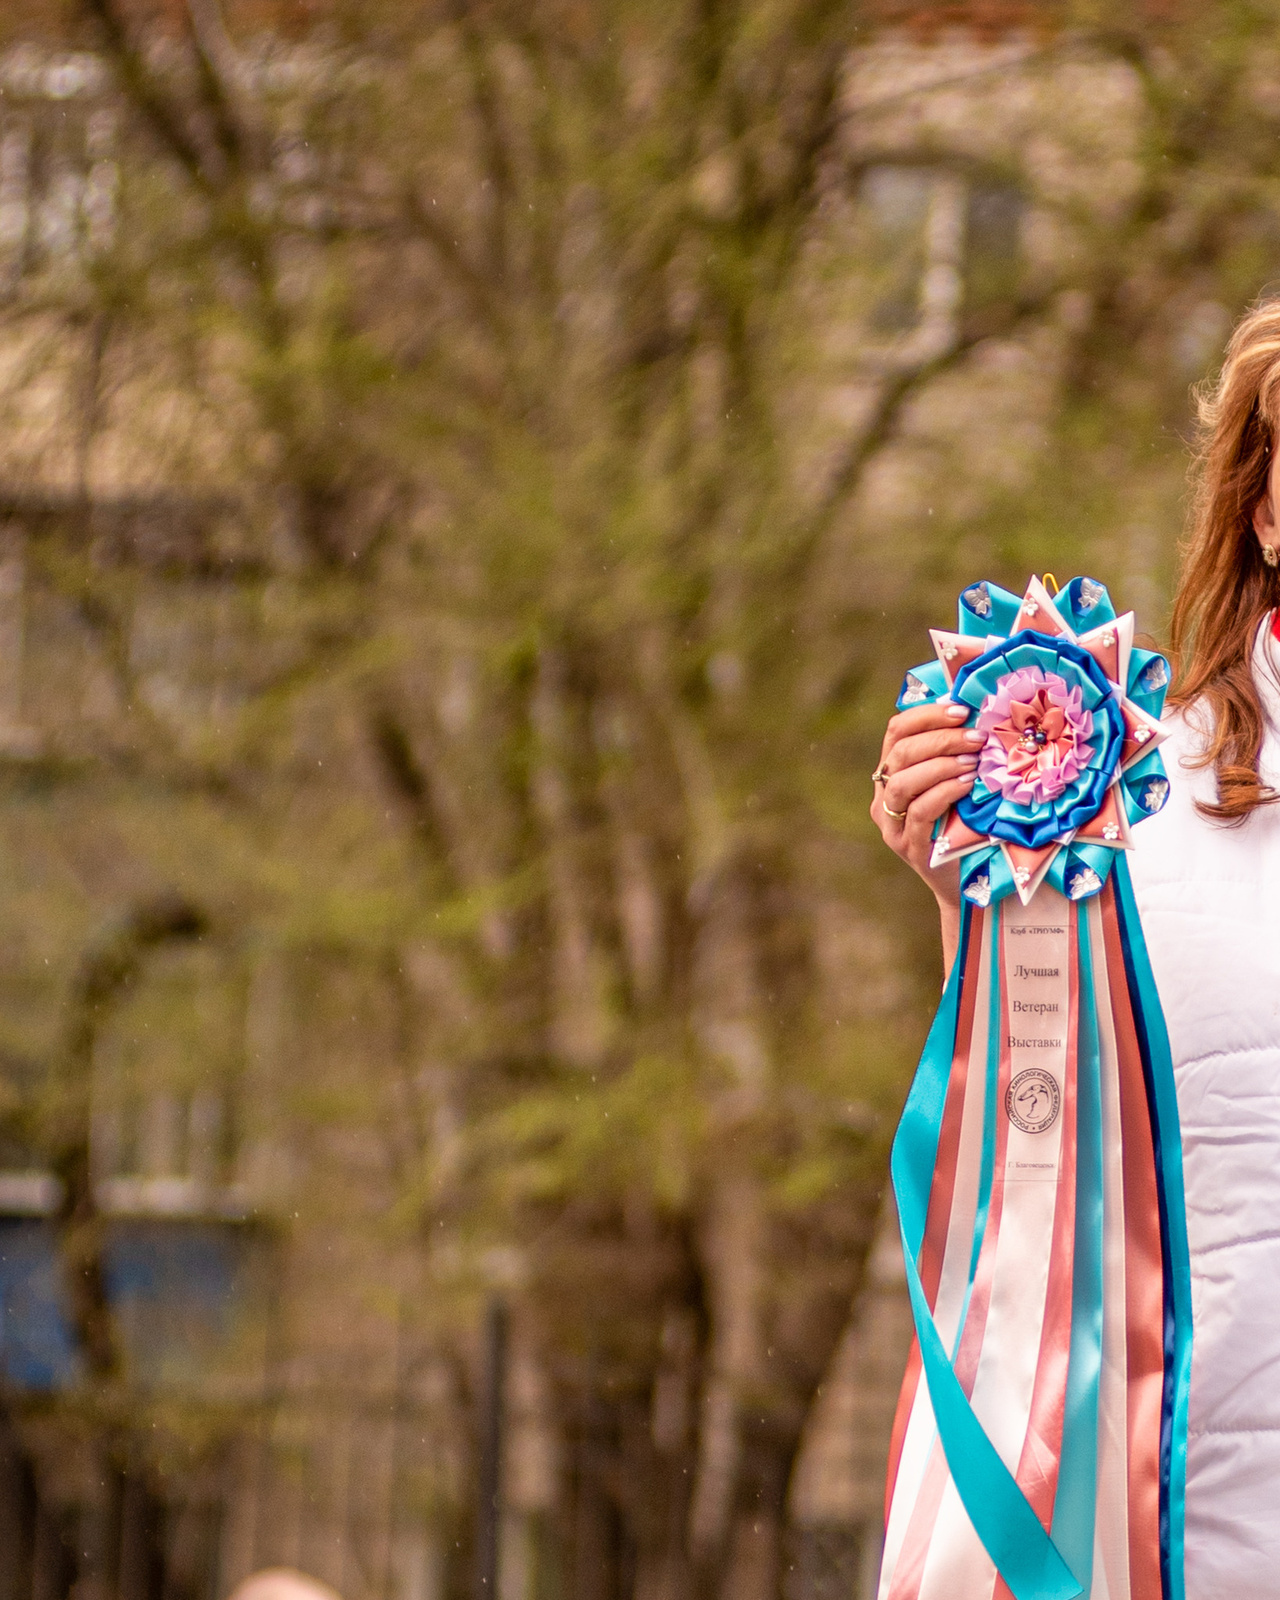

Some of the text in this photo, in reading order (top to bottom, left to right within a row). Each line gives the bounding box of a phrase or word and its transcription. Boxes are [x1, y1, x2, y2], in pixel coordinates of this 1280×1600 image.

[1013, 965, 1059, 979] Лучшая
[1012, 1000, 1059, 1015] Ветеран
[1007, 1036, 1062, 1048] Выставки
